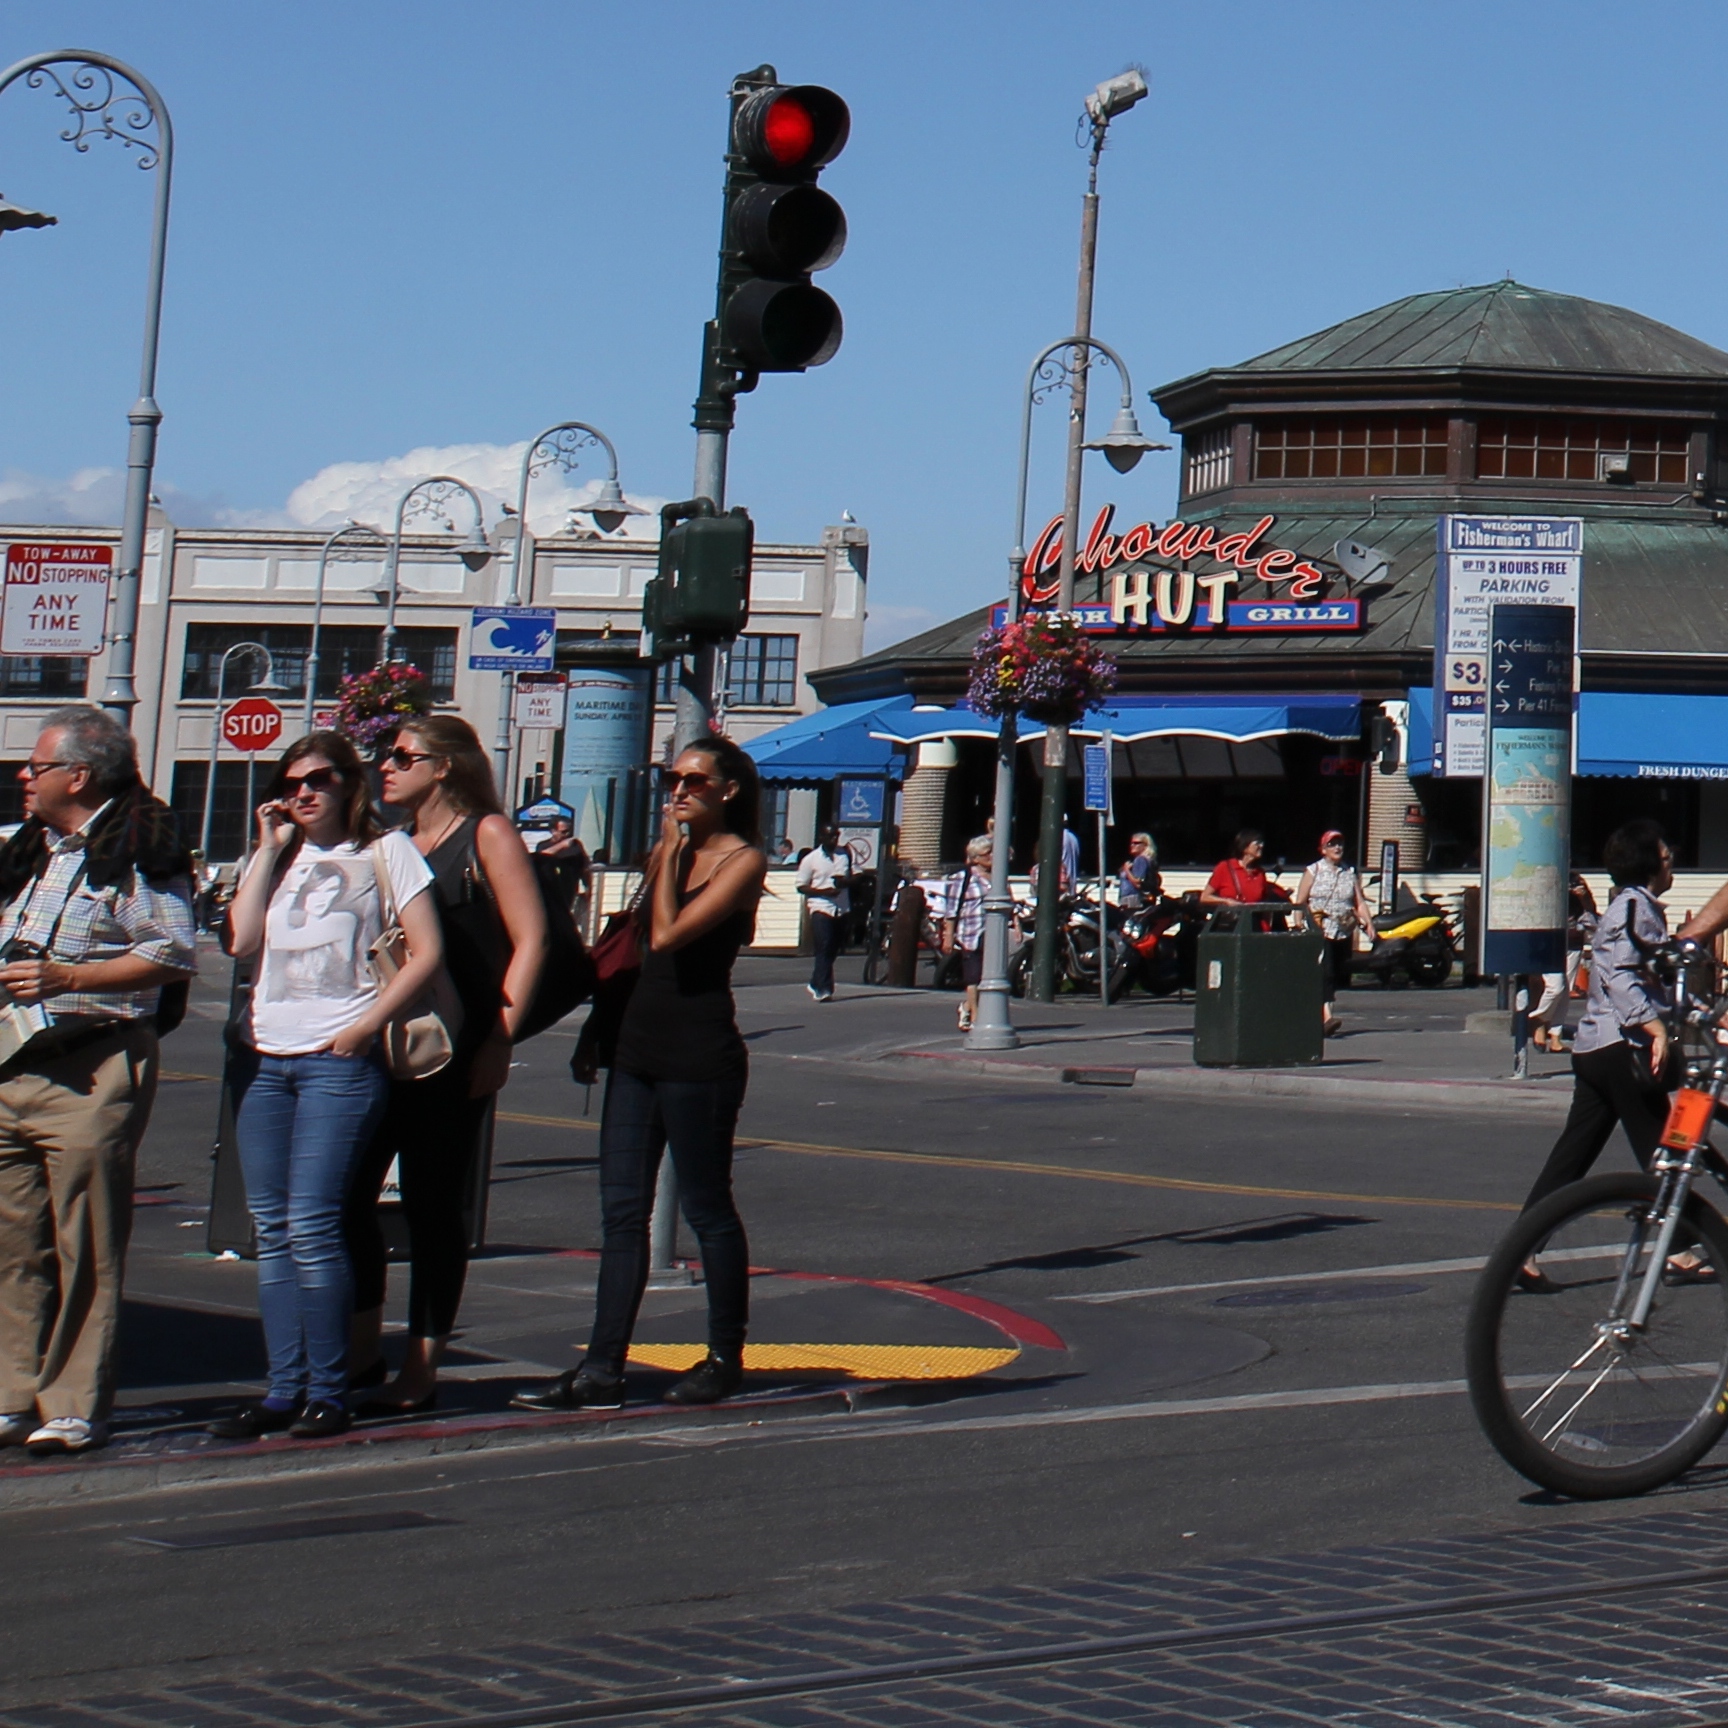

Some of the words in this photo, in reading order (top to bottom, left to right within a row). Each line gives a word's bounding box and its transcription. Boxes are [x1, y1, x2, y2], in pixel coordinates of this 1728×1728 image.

[1481, 522, 1532, 531] WELCOME
[1458, 522, 1531, 547] Fisherman's
[1536, 524, 1573, 547] Wharf
[23, 547, 97, 560] TOW-AWAY
[1022, 503, 1323, 602] Chowder
[7, 562, 37, 582] NO
[42, 568, 107, 583] STOPPING
[1462, 560, 1474, 569] UP
[1488, 561, 1496, 573] 3
[1499, 561, 1539, 574] HOURS
[1542, 562, 1567, 575] FREE
[1480, 579, 1550, 593] PARKING
[33, 594, 79, 610] ANY
[1110, 570, 1240, 625] HUT
[1248, 607, 1350, 621] GRILL
[28, 615, 81, 630] TIME
[1453, 662, 1486, 685] $3.
[530, 698, 551, 707] ANY
[575, 701, 626, 710] MARITIME
[1518, 698, 1535, 711] Pier
[1537, 698, 1548, 711] 41
[528, 708, 552, 717] TIME
[226, 714, 278, 736] STOP
[1638, 765, 1679, 776] FRESH
